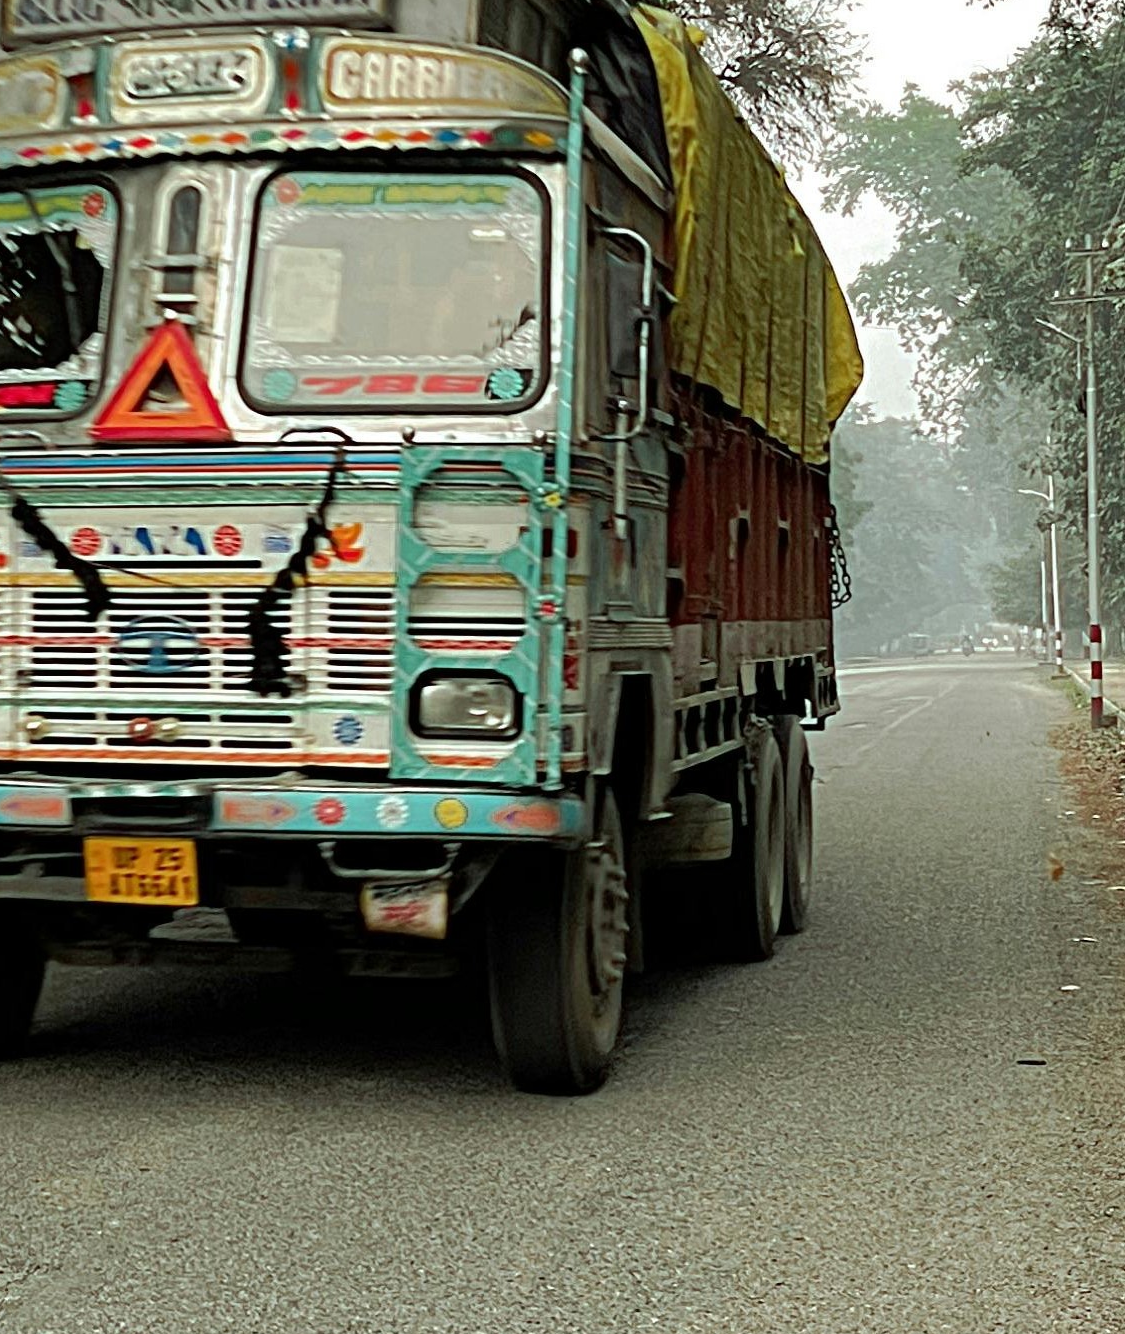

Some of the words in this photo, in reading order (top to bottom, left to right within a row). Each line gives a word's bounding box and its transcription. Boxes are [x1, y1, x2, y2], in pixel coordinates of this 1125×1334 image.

[301, 373, 486, 395] 786
[111, 846, 139, 869] UP
[153, 847, 184, 871] 25
